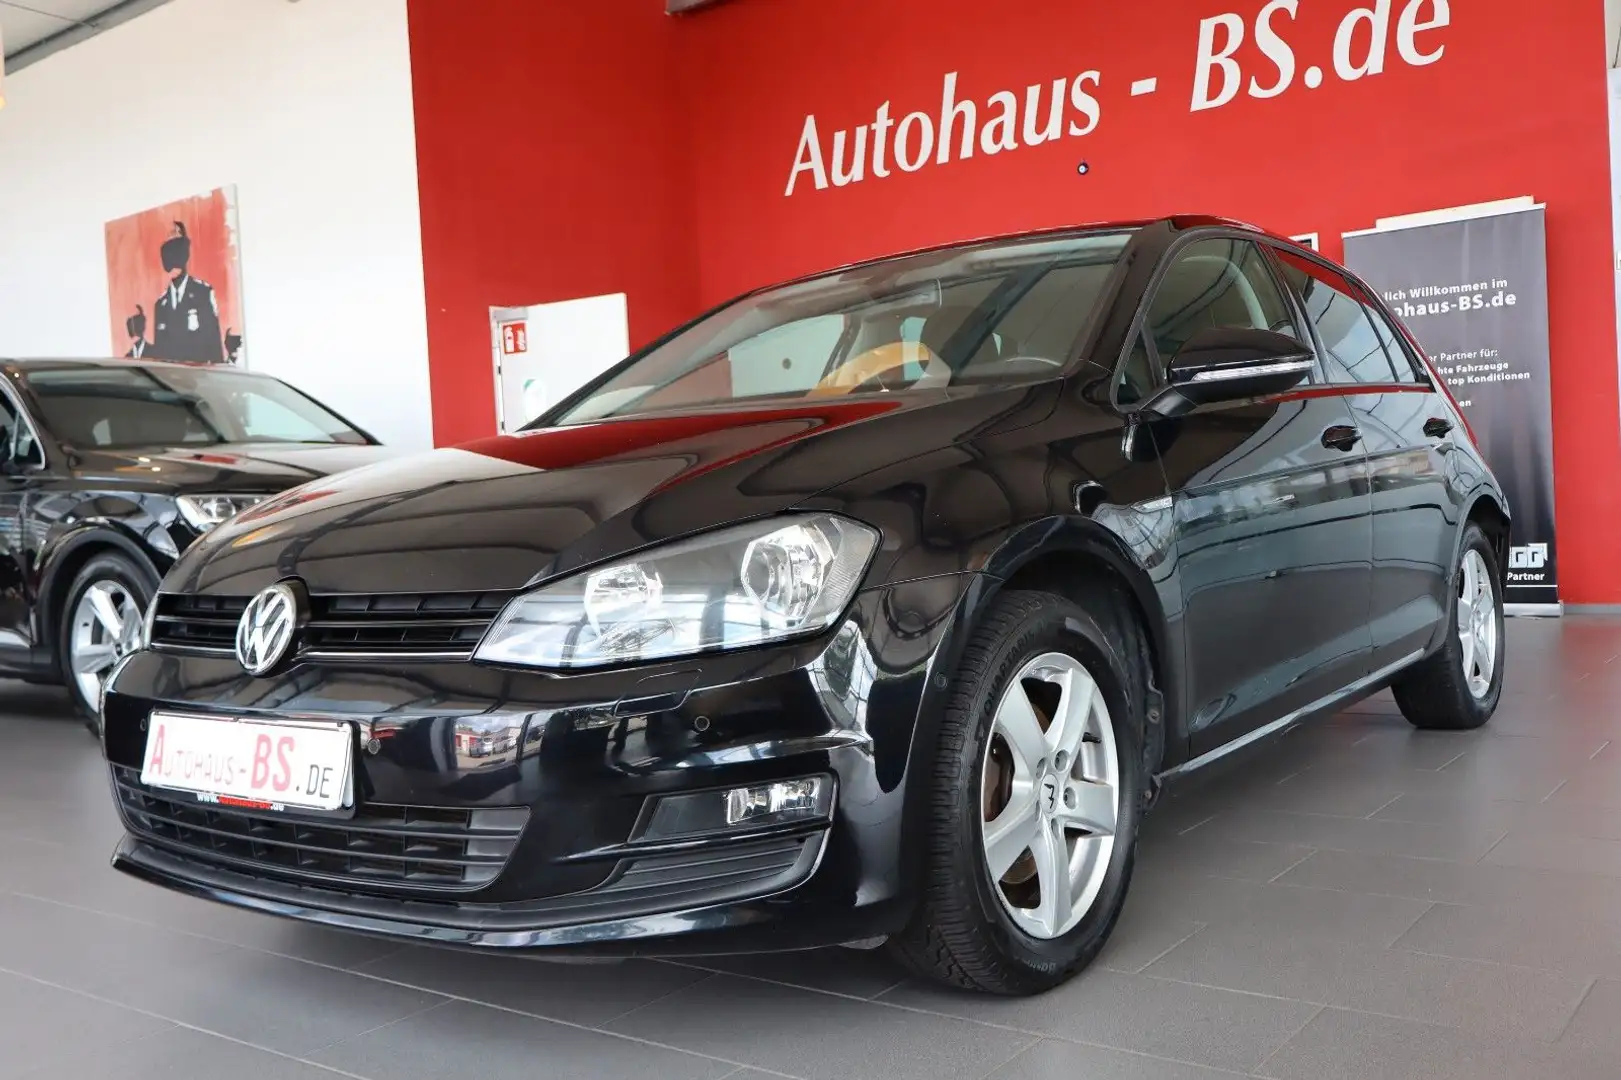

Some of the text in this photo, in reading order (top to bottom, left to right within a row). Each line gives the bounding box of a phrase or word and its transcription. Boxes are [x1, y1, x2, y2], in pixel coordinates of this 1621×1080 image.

[784, 70, 1101, 196] Autohaus
[1190, 0, 1450, 112] BS.de
[1382, 278, 1508, 302] lich Willkommen im
[1393, 291, 1517, 317] ohaus-BS.de
[1440, 352, 1477, 362] Partner
[1456, 362, 1509, 374] Fahrzeuge
[1448, 372, 1531, 387] top Konditionen
[1507, 572, 1545, 581] Partner
